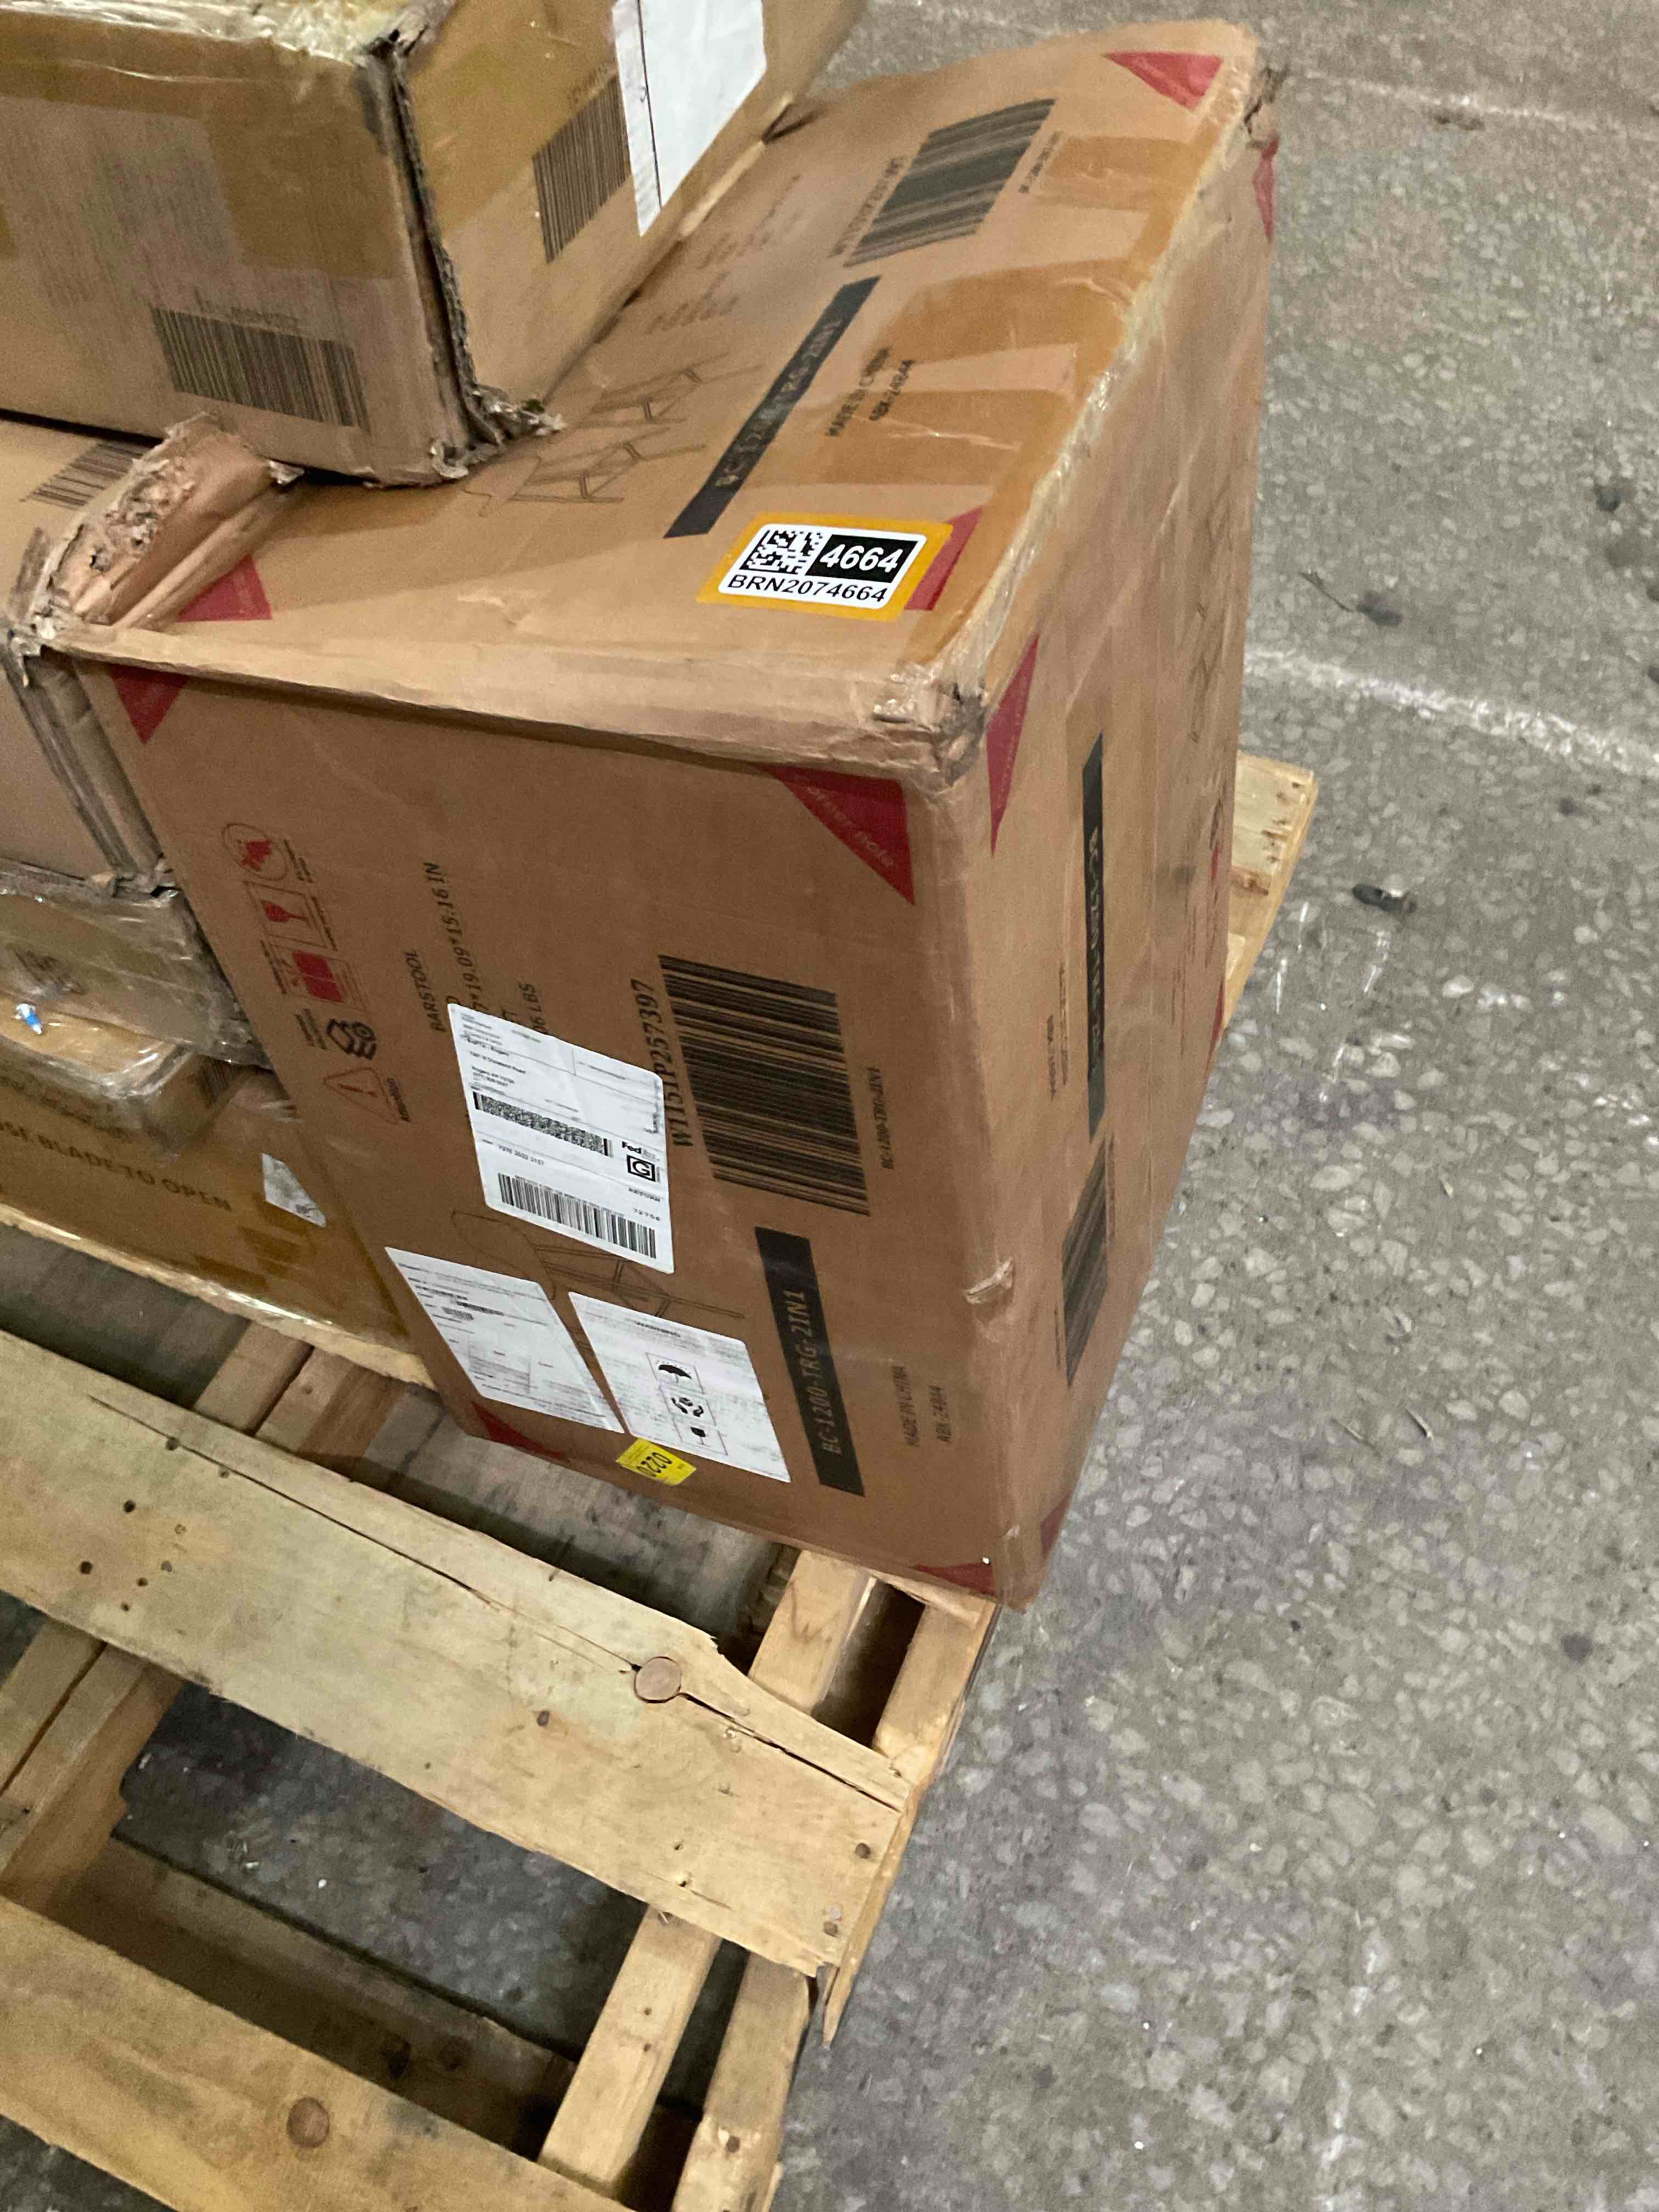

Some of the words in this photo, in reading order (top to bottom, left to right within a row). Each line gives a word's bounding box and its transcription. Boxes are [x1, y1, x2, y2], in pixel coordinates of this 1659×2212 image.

[820, 544, 903, 573] 4664
[727, 574, 889, 602] BRN2074664
[404, 950, 445, 1032] BARSTOOL
[632, 1160, 650, 1176] G
